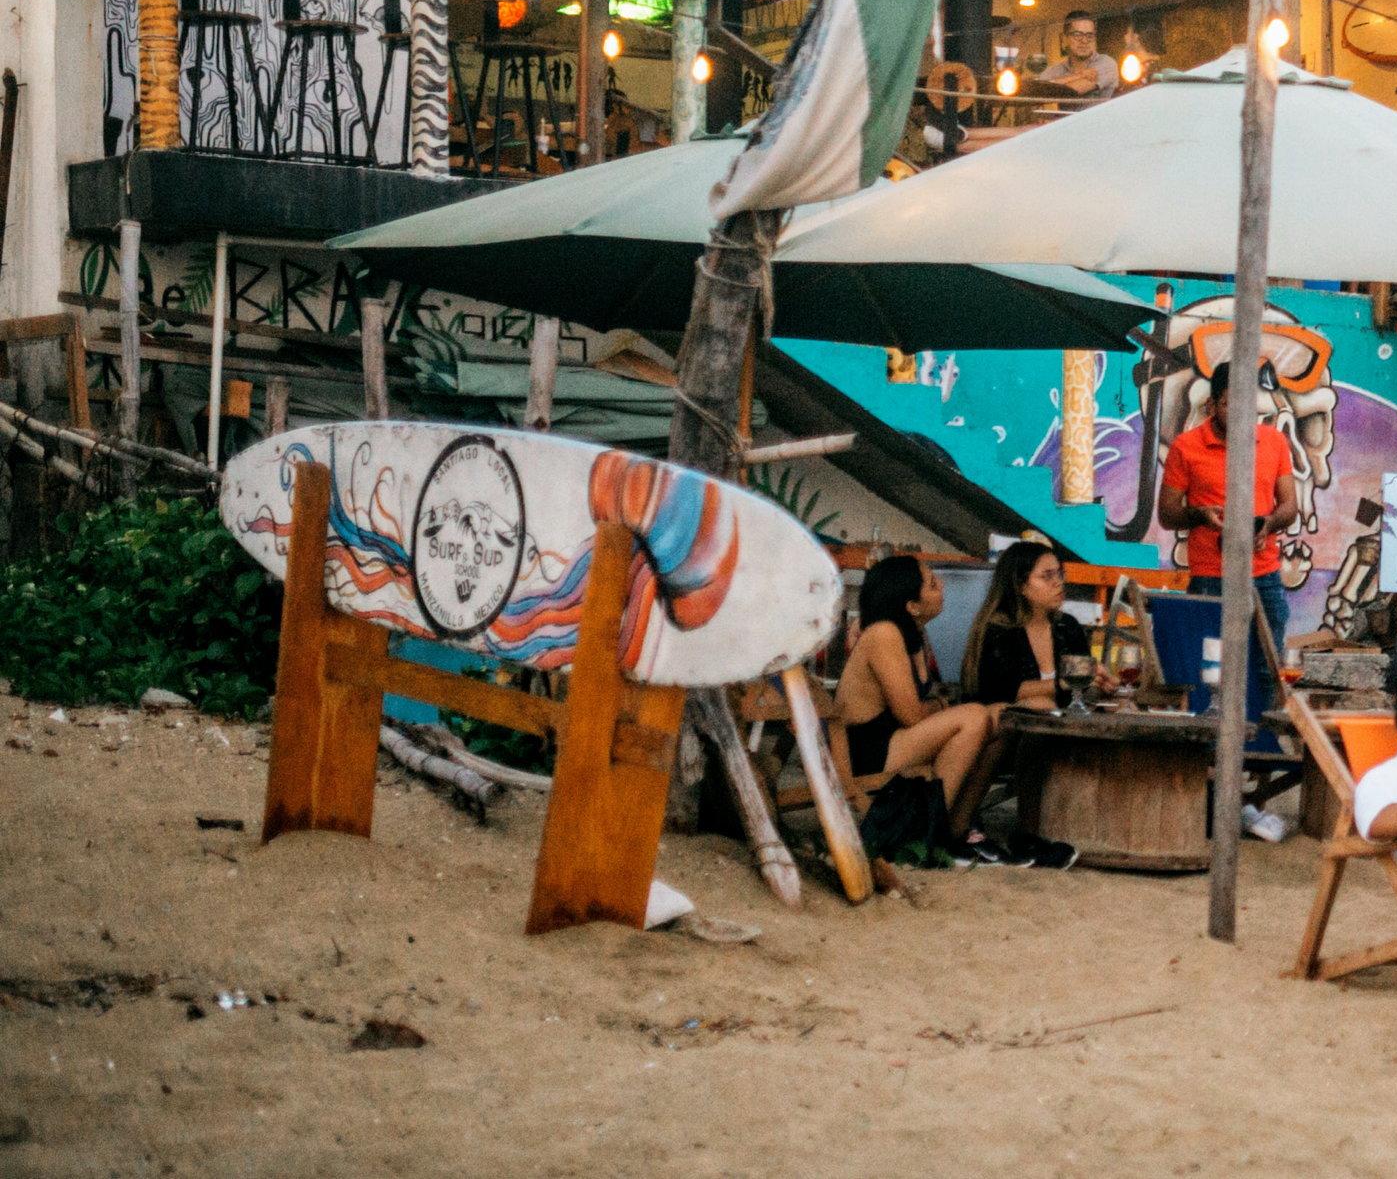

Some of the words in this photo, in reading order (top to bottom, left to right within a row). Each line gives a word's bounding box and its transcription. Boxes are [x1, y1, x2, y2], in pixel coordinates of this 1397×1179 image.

[433, 447, 478, 485] SANTIAGO
[487, 454, 512, 494] LOCAL
[454, 563, 481, 579] SCHOOL
[420, 572, 464, 627] MANZANILLO
[474, 584, 504, 623] MEXICO
